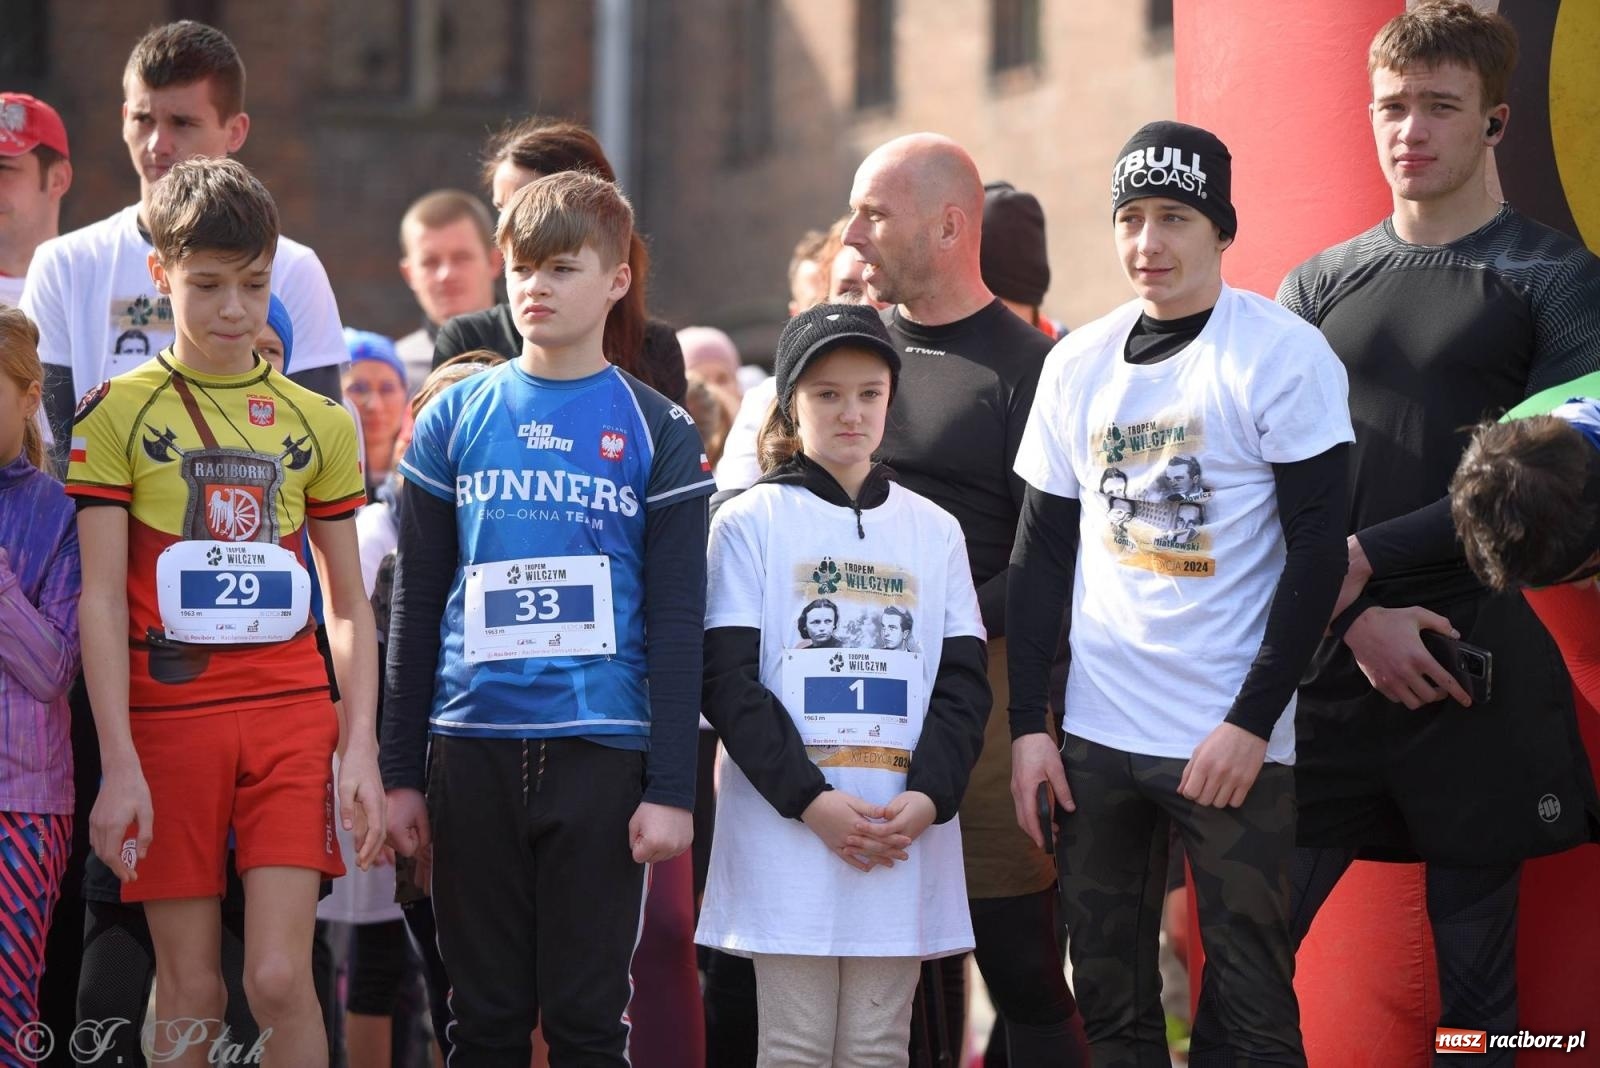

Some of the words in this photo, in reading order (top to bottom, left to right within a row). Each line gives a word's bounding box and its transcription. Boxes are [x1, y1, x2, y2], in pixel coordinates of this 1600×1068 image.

[1112, 147, 1207, 185] TBULL
[1130, 167, 1206, 197] COAST
[602, 424, 628, 434] POLAND
[1127, 421, 1157, 436] TROPEM
[1129, 426, 1185, 452] WILCZYM
[456, 469, 639, 517] RUNNERS
[227, 554, 266, 565] WILCZYM
[844, 562, 875, 575] TROPEM
[1184, 561, 1209, 572] 2024
[525, 569, 567, 582] WILCZYM
[846, 573, 904, 594] WILCZYM
[215, 572, 260, 605] 29
[515, 588, 561, 622] 33
[849, 660, 887, 672] WILCZYM
[848, 679, 865, 711] 1
